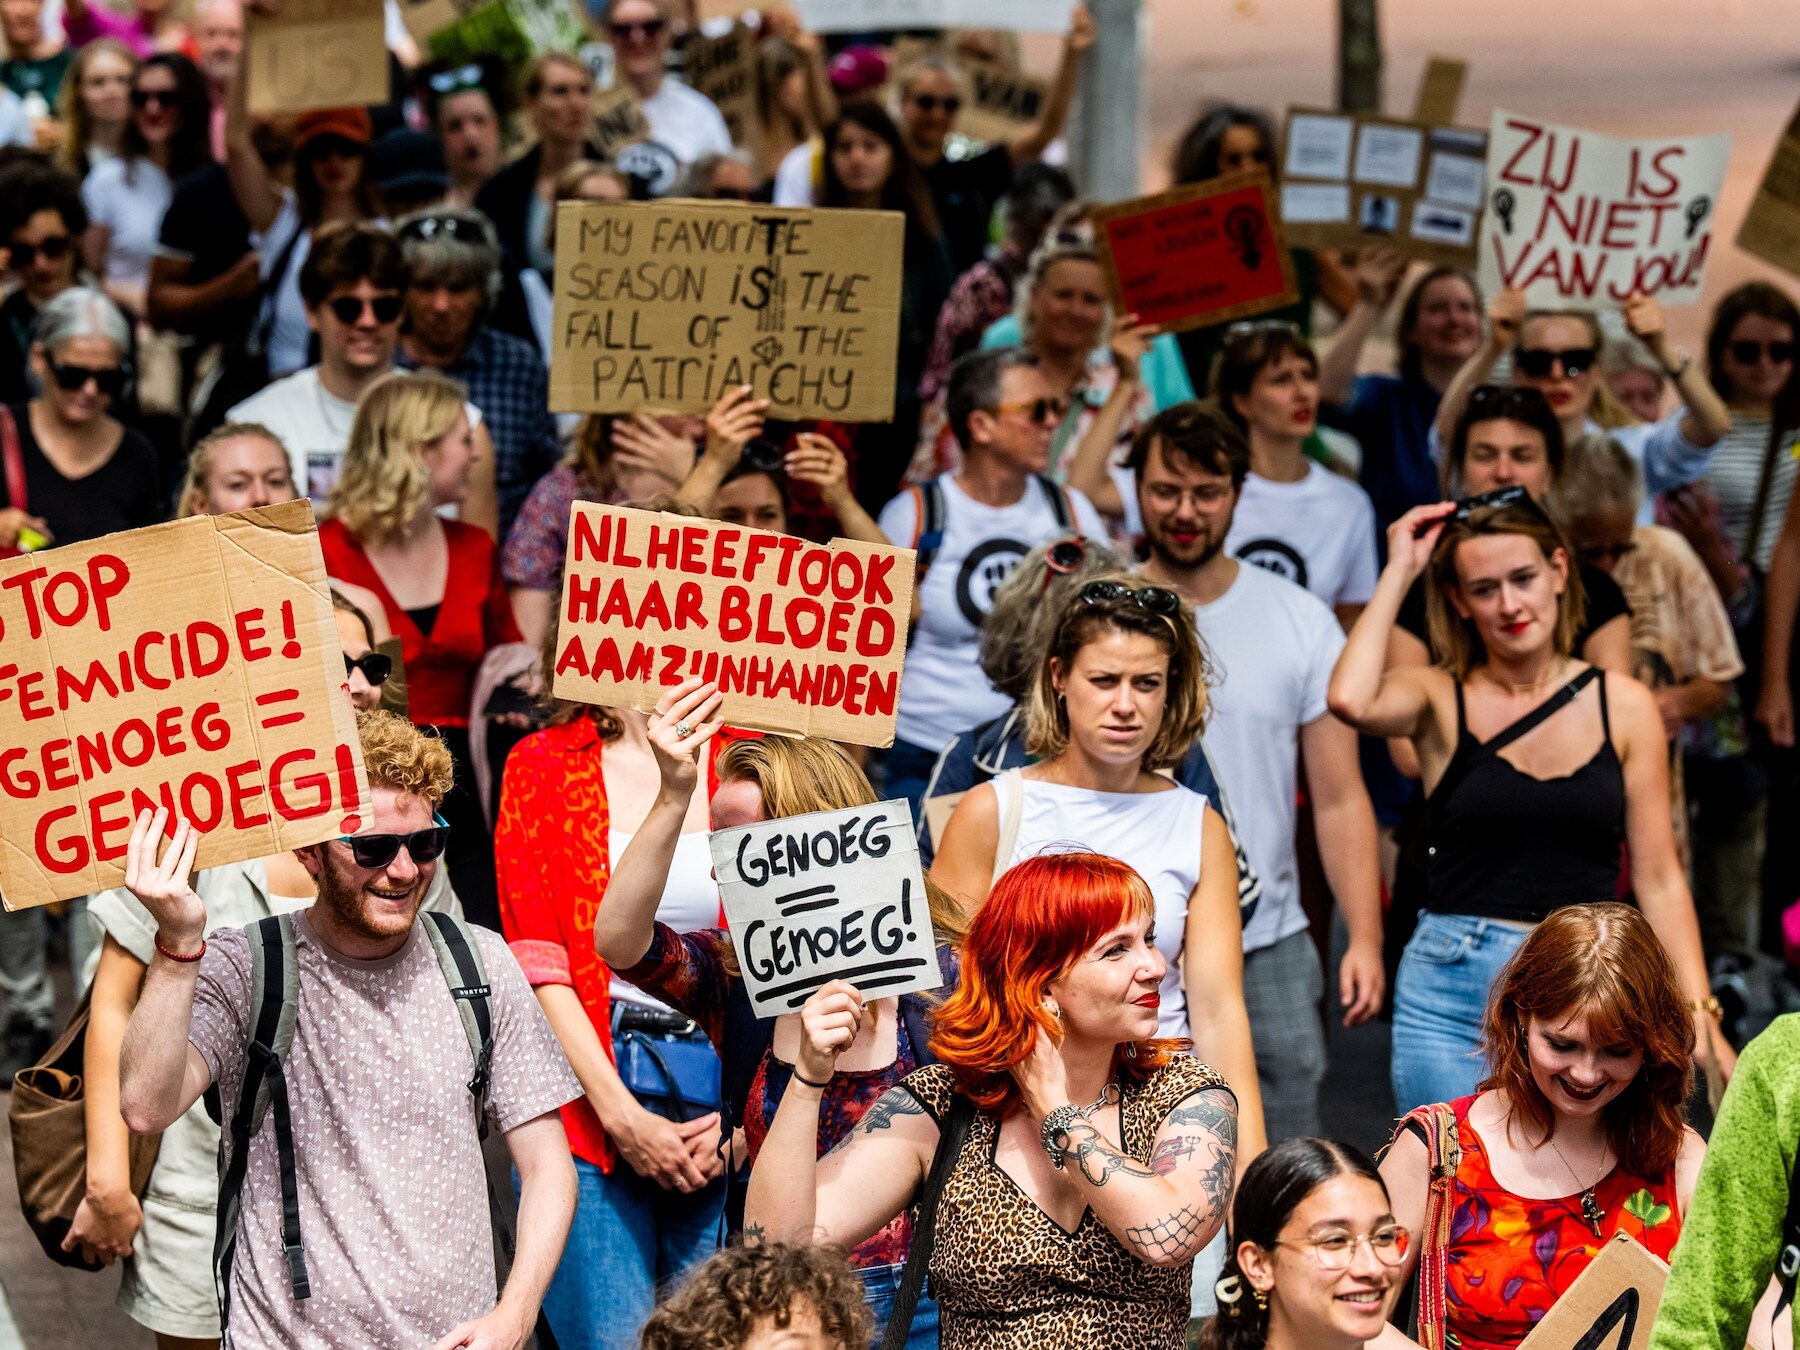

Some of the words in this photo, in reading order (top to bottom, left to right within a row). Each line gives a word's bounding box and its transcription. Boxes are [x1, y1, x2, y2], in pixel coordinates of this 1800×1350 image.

[1628, 146, 1685, 199] IS
[579, 217, 633, 256] MY
[1536, 195, 1679, 249] NIET
[567, 262, 706, 302] SEASON
[800, 271, 870, 313] THE
[1493, 233, 1608, 298] VAN
[565, 309, 653, 350] FALL
[688, 314, 730, 349] OF
[796, 325, 866, 357] THE
[0, 554, 130, 642] TOP
[567, 574, 709, 631] HAAR
[718, 585, 896, 657] BLOED
[0, 702, 231, 799] GENOEG
[34, 743, 361, 874] GENOEG!
[736, 815, 891, 887] GENOEG
